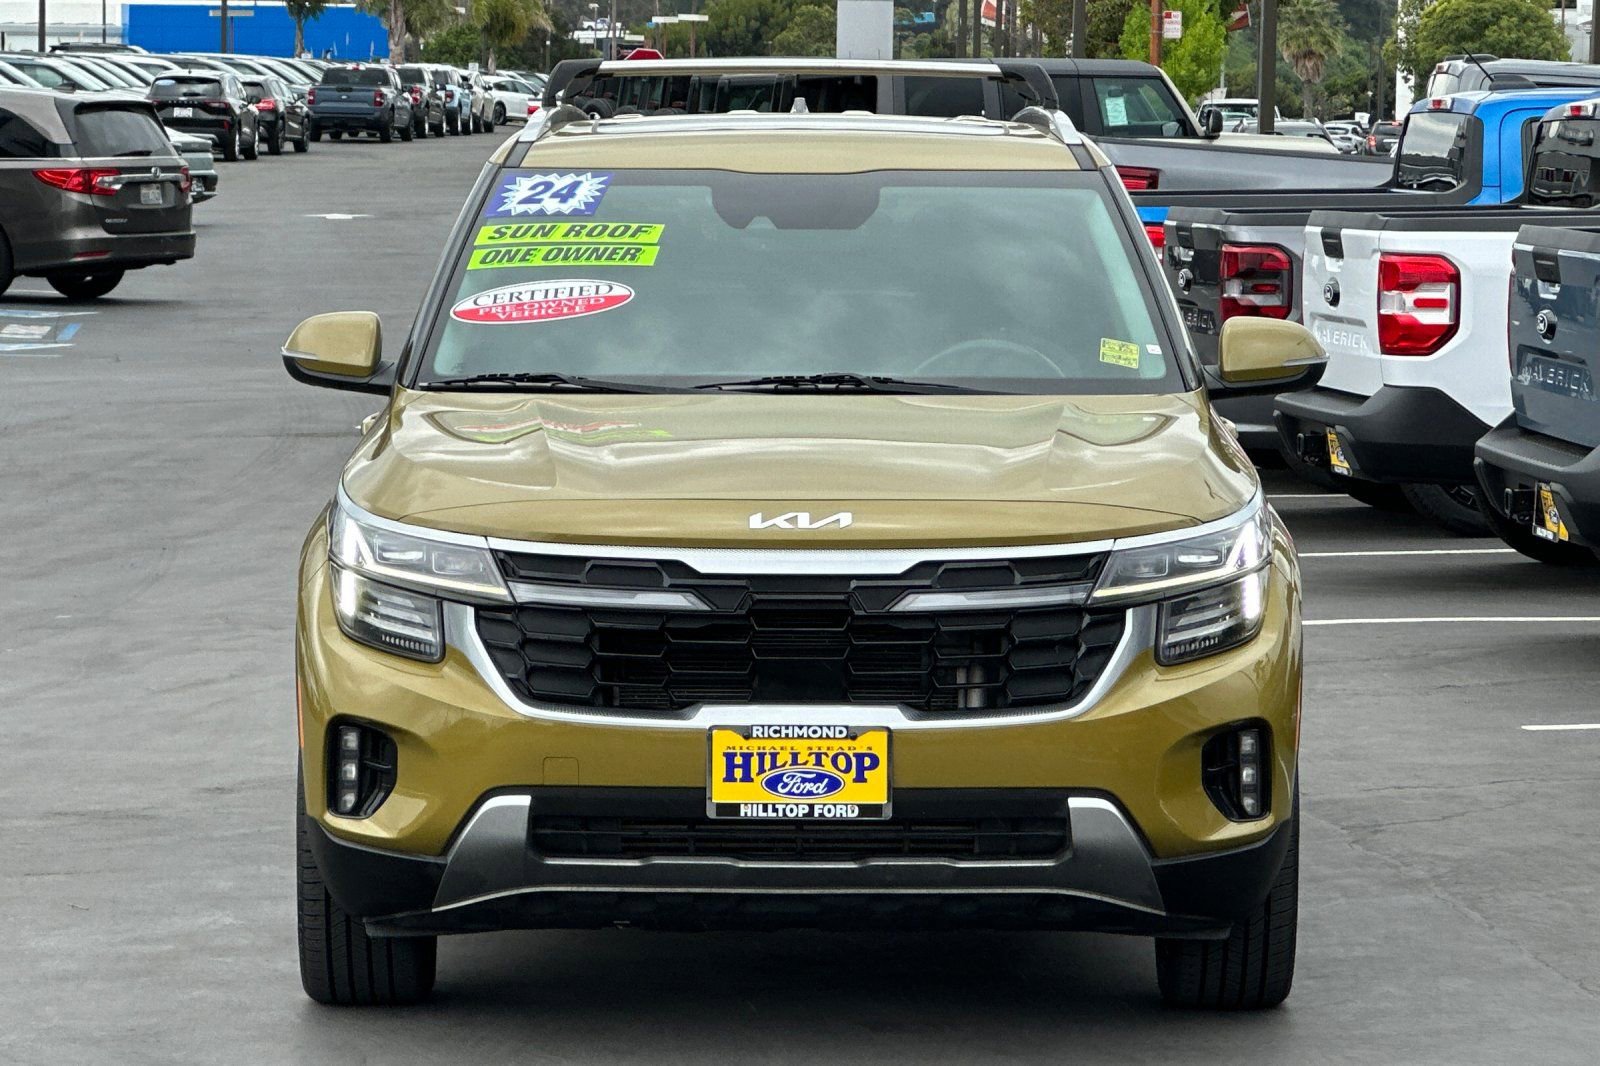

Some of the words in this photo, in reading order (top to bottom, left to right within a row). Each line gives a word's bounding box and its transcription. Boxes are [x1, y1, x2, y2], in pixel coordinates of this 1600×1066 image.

[517, 179, 584, 205] 24
[488, 224, 559, 240] SUN
[562, 224, 655, 239] ROOF
[479, 247, 538, 265] ONE
[542, 246, 644, 263] OWNER
[473, 284, 614, 307] CERTIFIED
[479, 297, 605, 315] PRE-OWNED
[497, 305, 586, 319] VEHICLE
[752, 726, 848, 739] RICHMOND
[723, 751, 880, 783] HILLTOP
[777, 771, 829, 795] Ford
[740, 804, 809, 818] HILLTOP
[814, 804, 859, 818] FORD
